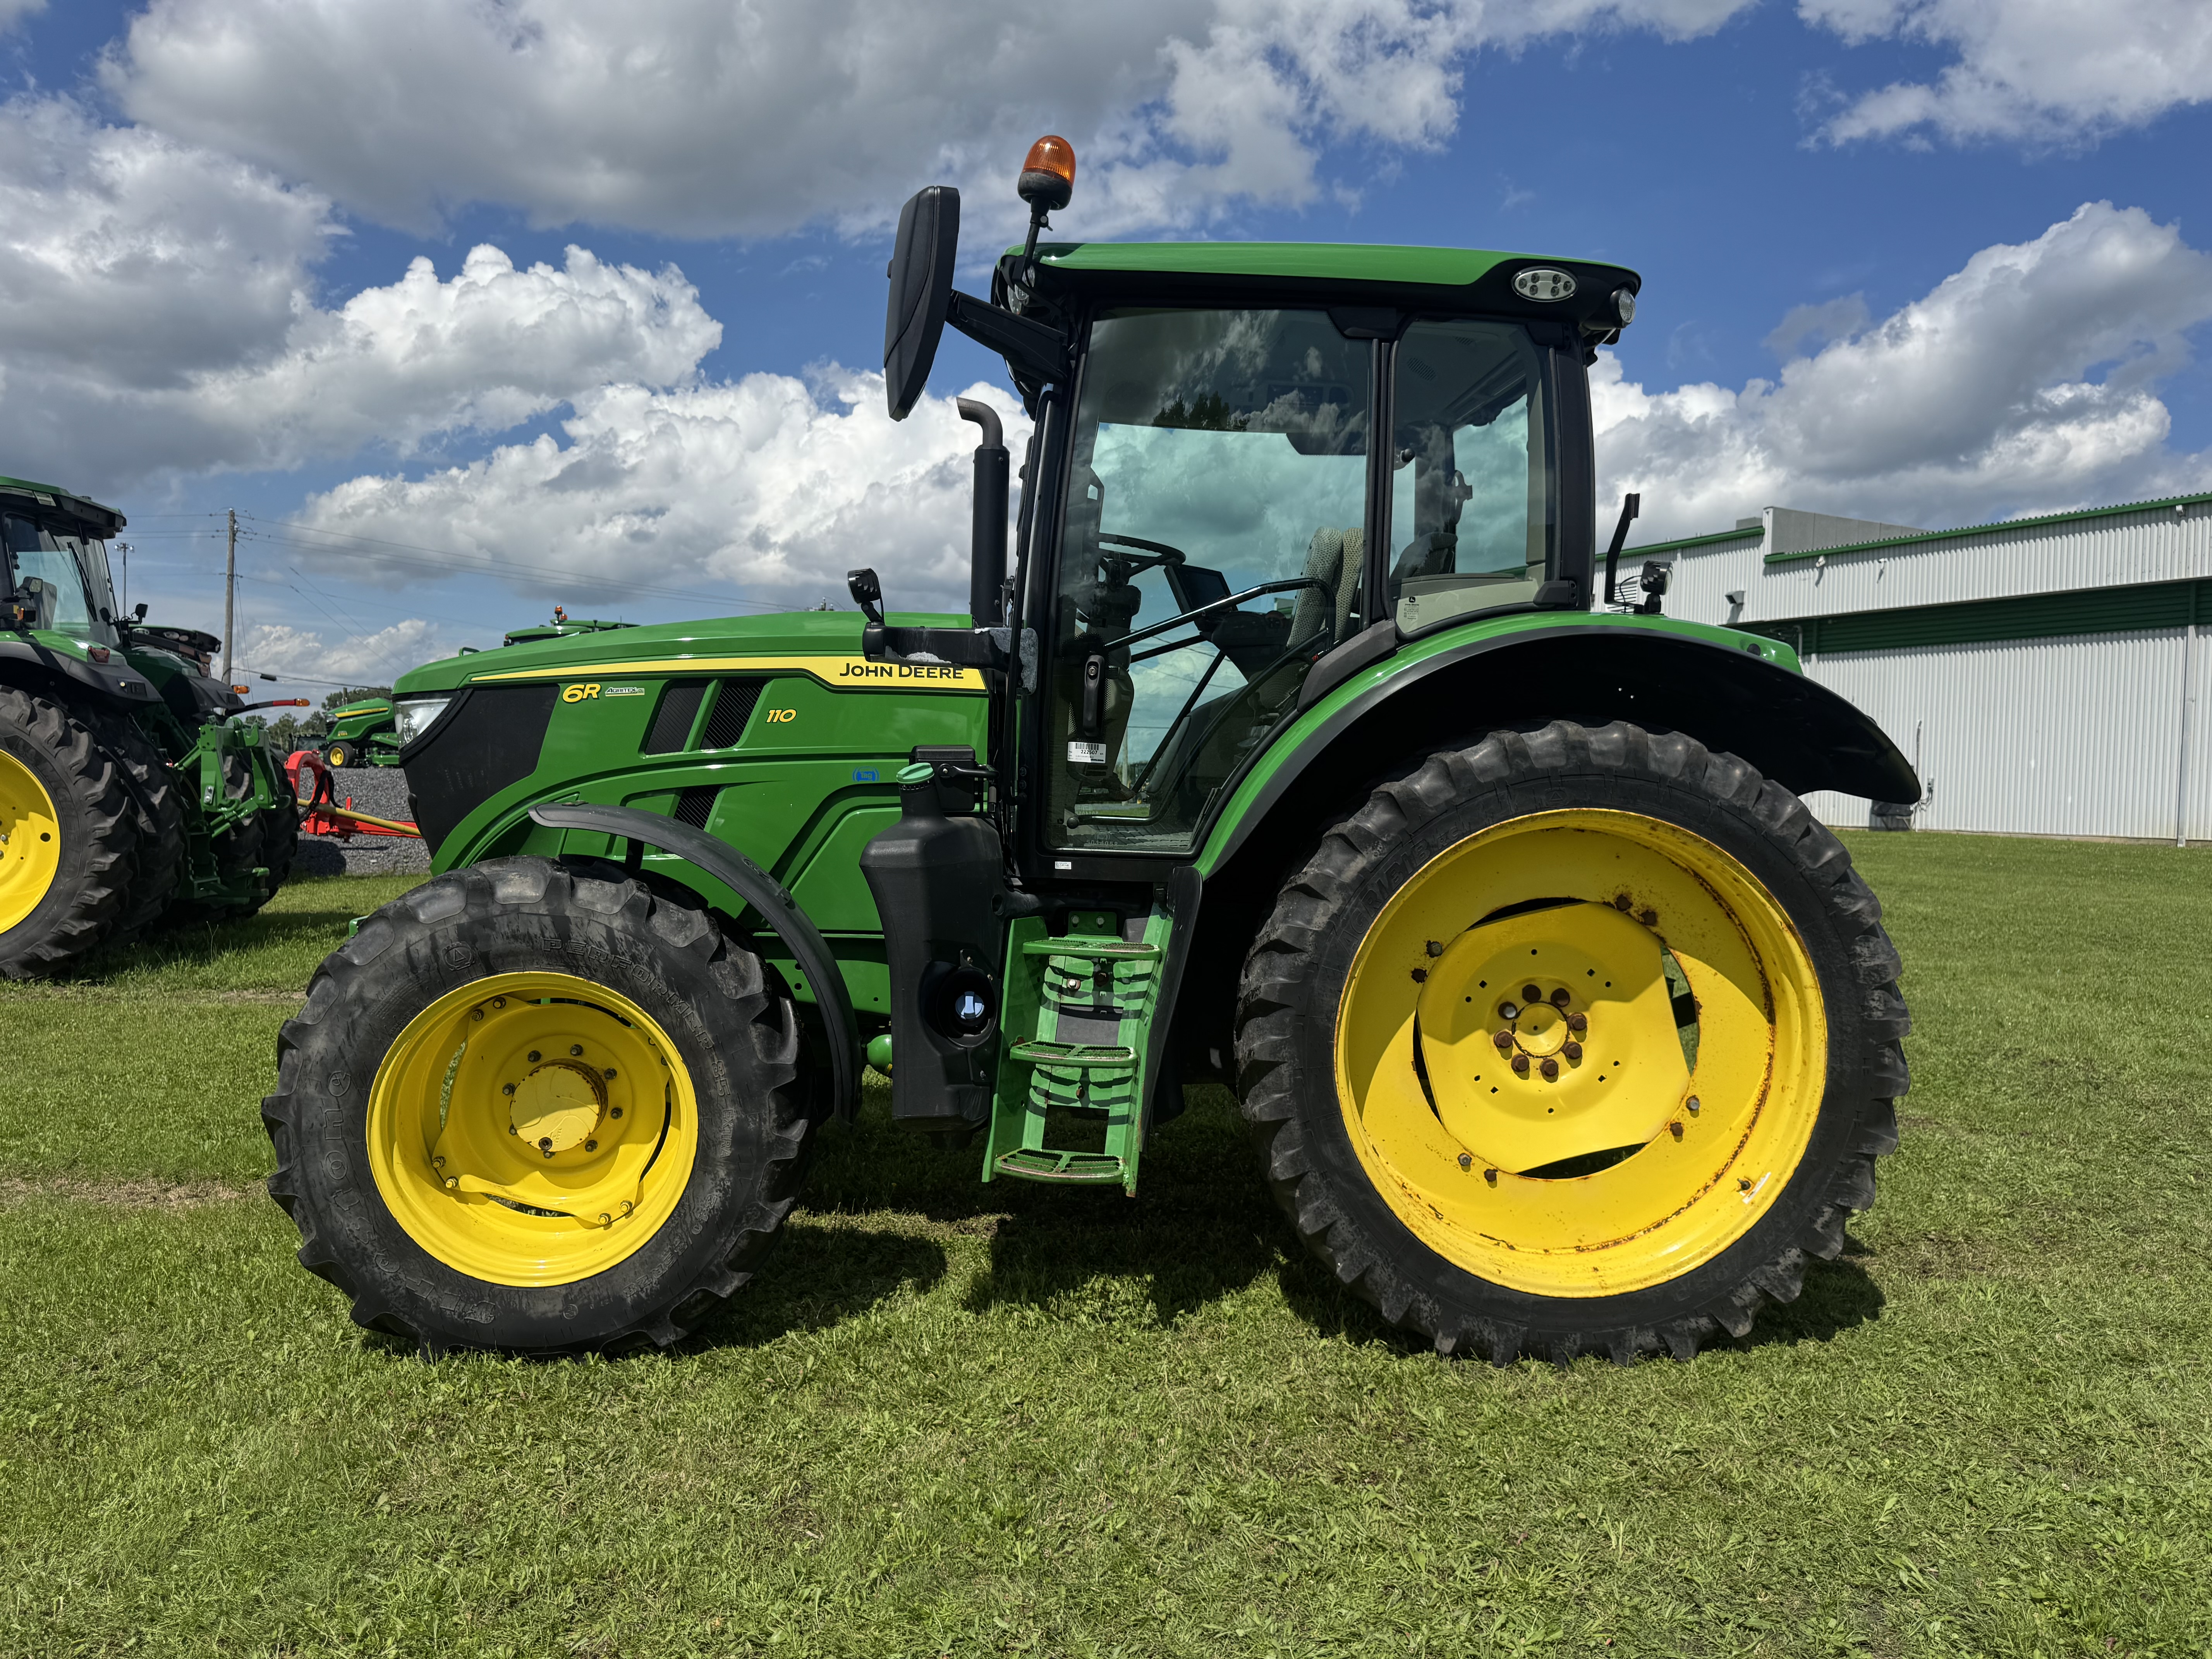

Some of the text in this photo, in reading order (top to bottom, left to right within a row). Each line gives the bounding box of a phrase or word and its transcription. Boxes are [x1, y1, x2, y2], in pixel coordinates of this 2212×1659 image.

[840, 663, 964, 679] JOHN DEERE
[563, 684, 601, 703] 6R
[766, 709, 797, 723] 110
[543, 938, 714, 1050] PERFORMER
[720, 1109, 734, 1158] EXTRA
